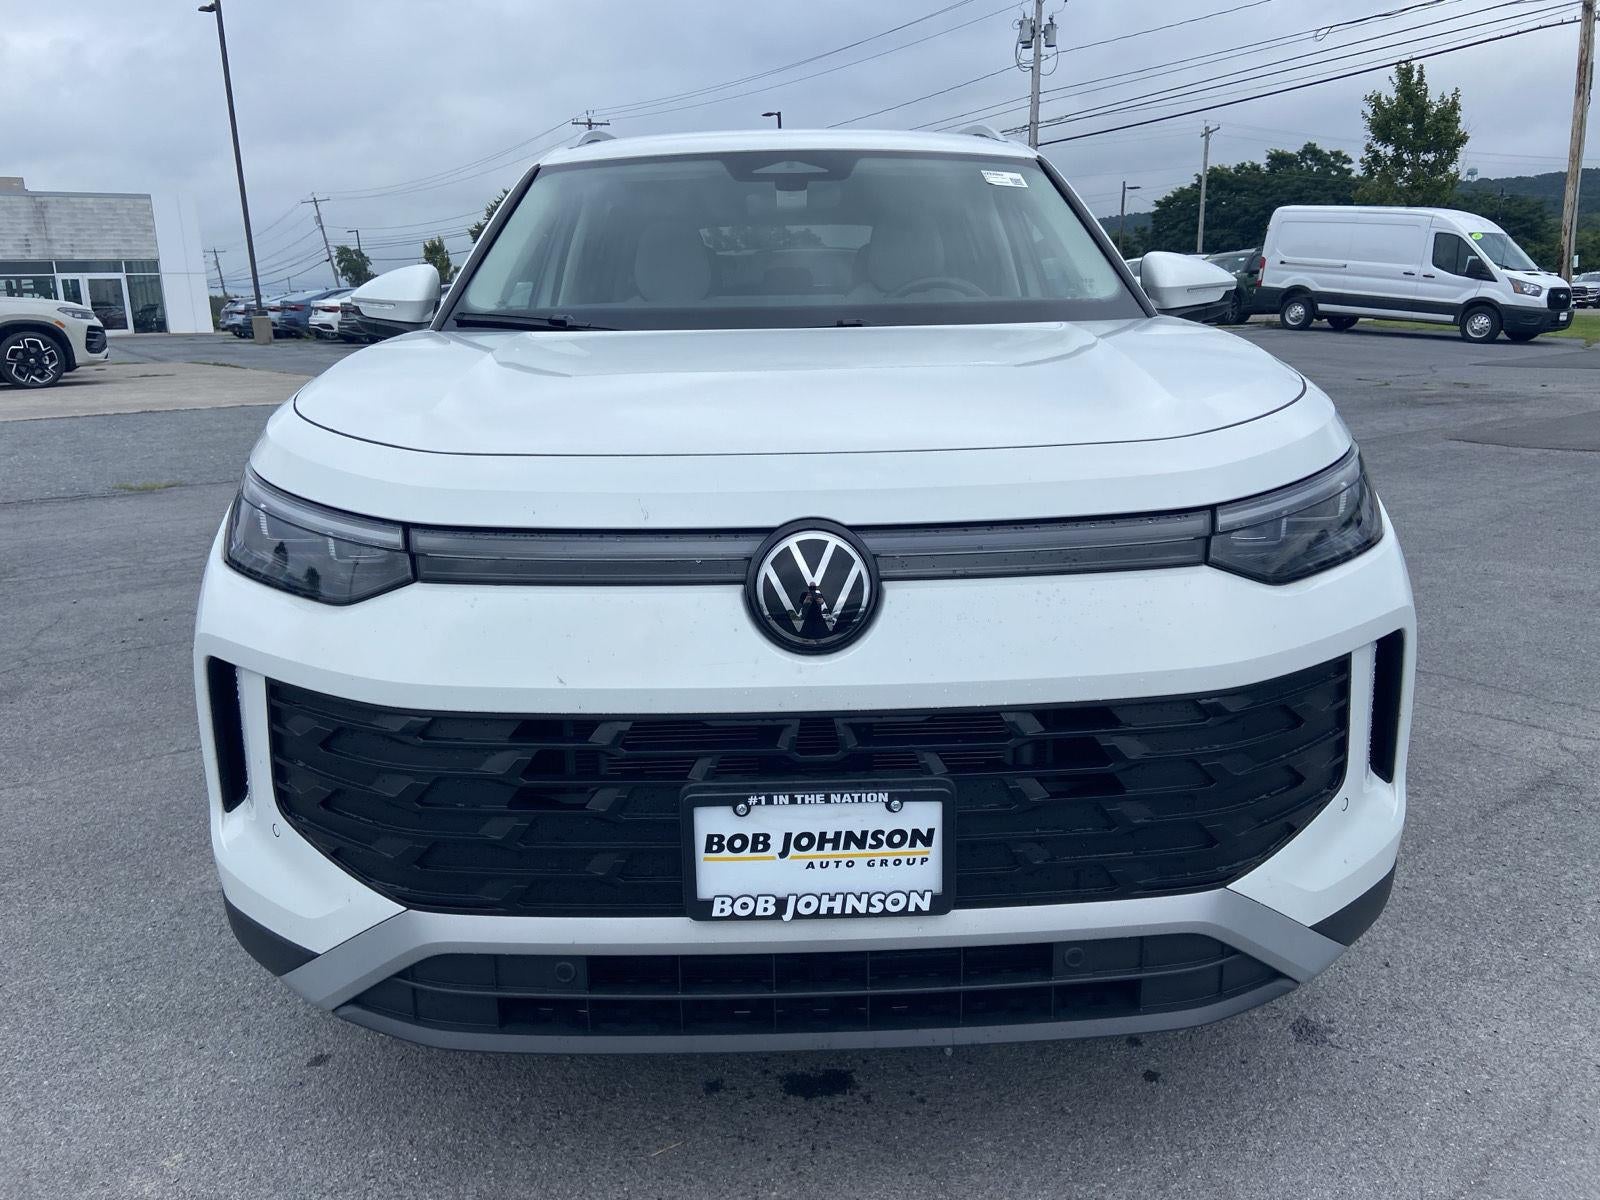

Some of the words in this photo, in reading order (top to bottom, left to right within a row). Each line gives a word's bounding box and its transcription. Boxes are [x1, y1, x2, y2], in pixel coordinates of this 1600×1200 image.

[759, 533, 869, 637] VW
[747, 794, 766, 806] #1
[773, 794, 790, 805] IN
[794, 793, 825, 805] THE
[830, 791, 889, 804] NATION
[704, 832, 771, 854] BOB
[778, 827, 936, 859] JOHNSON
[805, 859, 856, 870] AUTO
[866, 857, 929, 868] GROUP
[711, 894, 777, 917] BOB
[781, 890, 934, 922] JOHNSON
